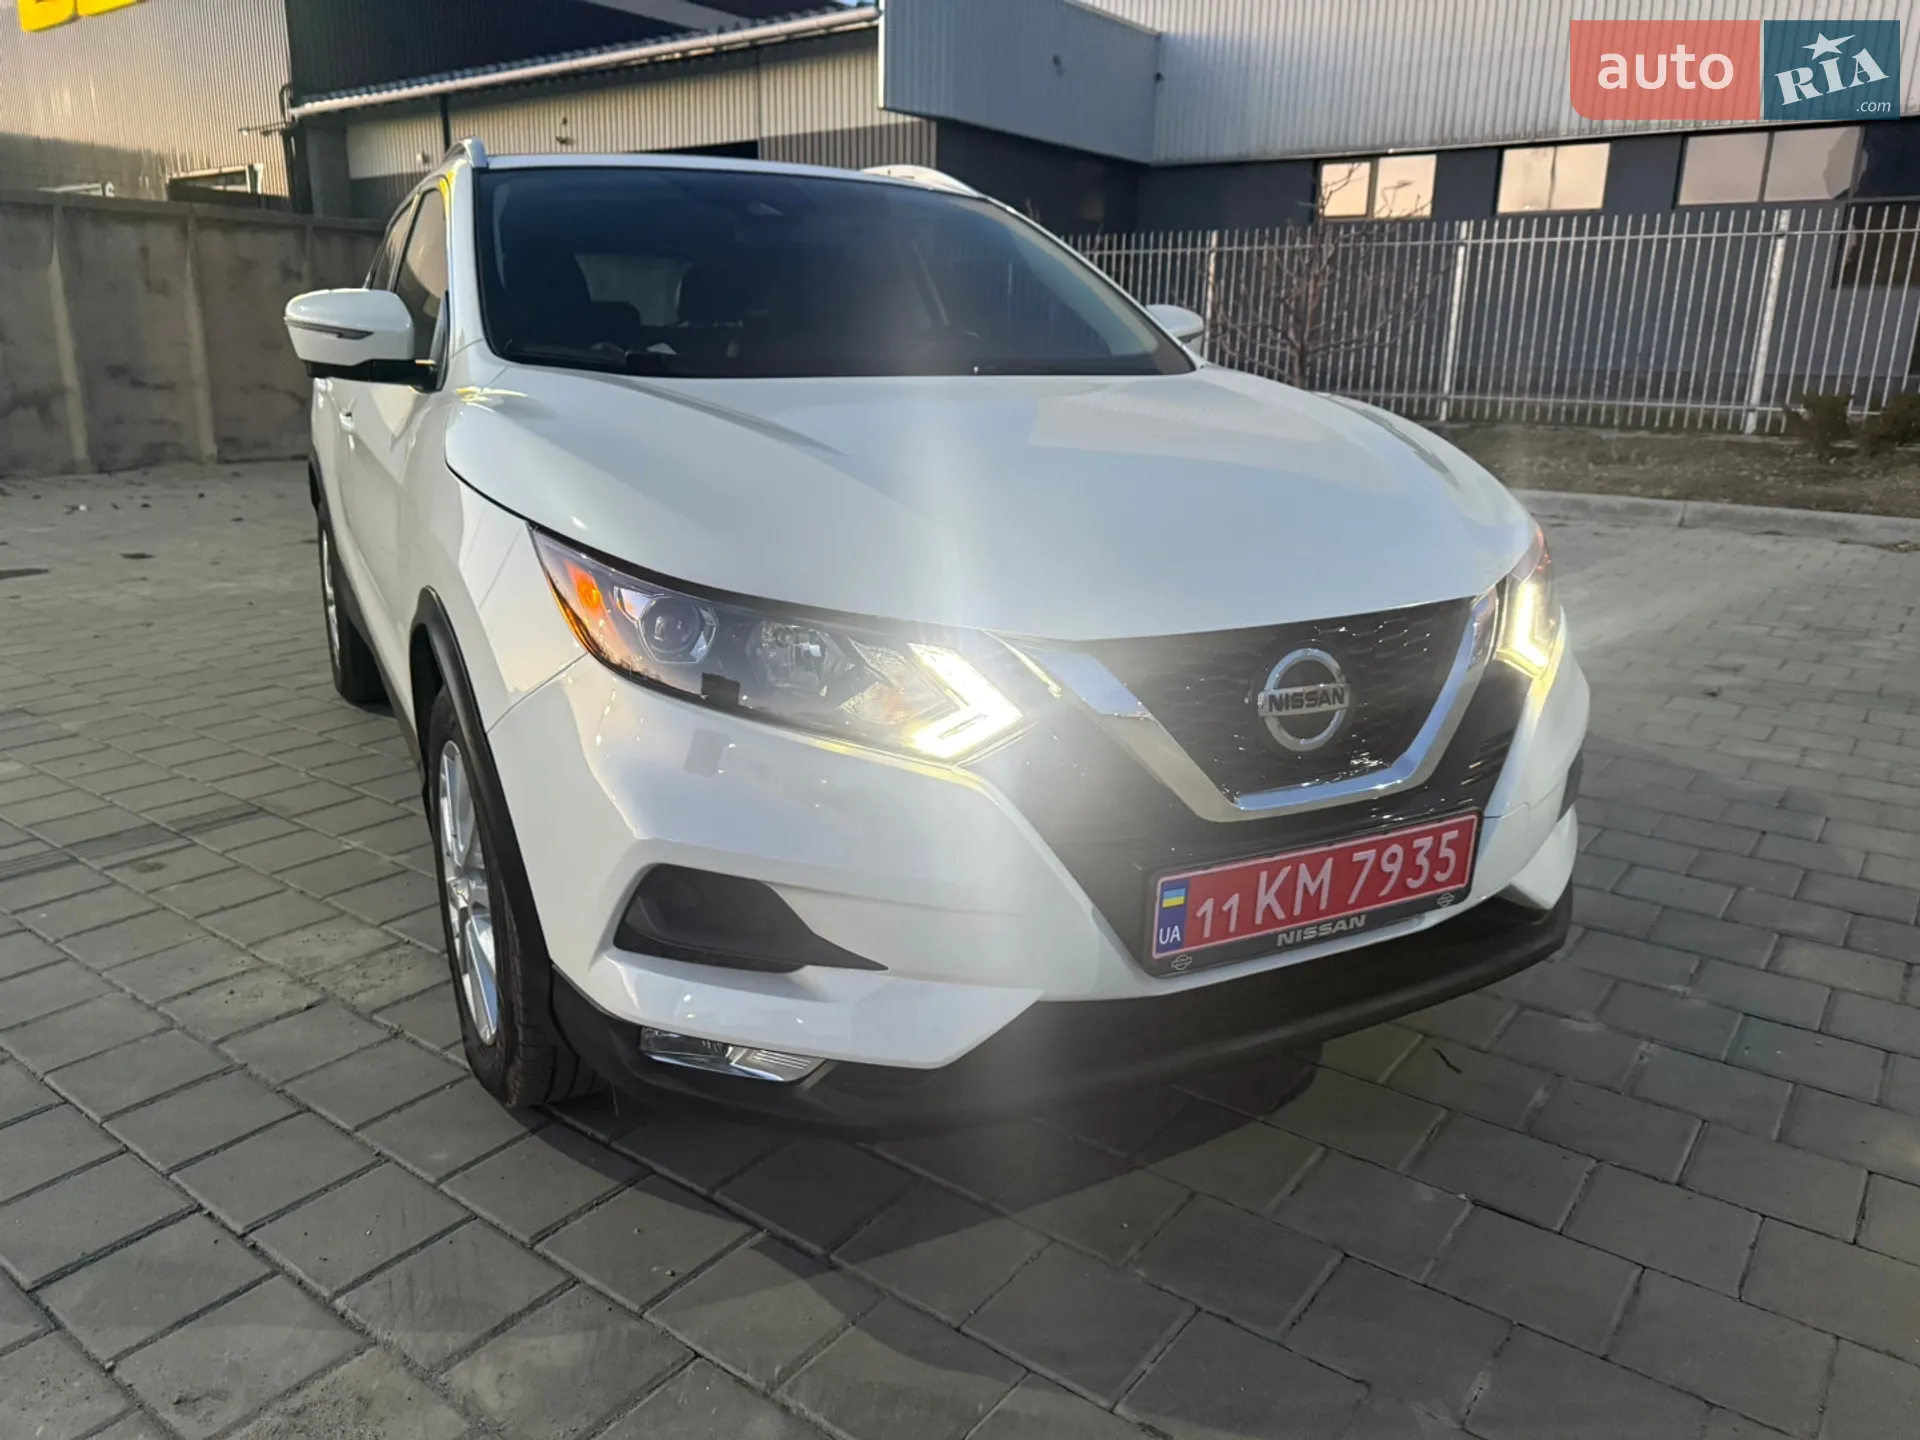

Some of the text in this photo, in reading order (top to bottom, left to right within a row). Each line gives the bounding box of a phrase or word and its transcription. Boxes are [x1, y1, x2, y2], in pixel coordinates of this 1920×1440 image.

[1268, 687, 1344, 712] NISSAN
[1195, 830, 1460, 938] 11 KM 7935
[1159, 927, 1181, 945] UA
[1276, 914, 1366, 947] NISSAN
